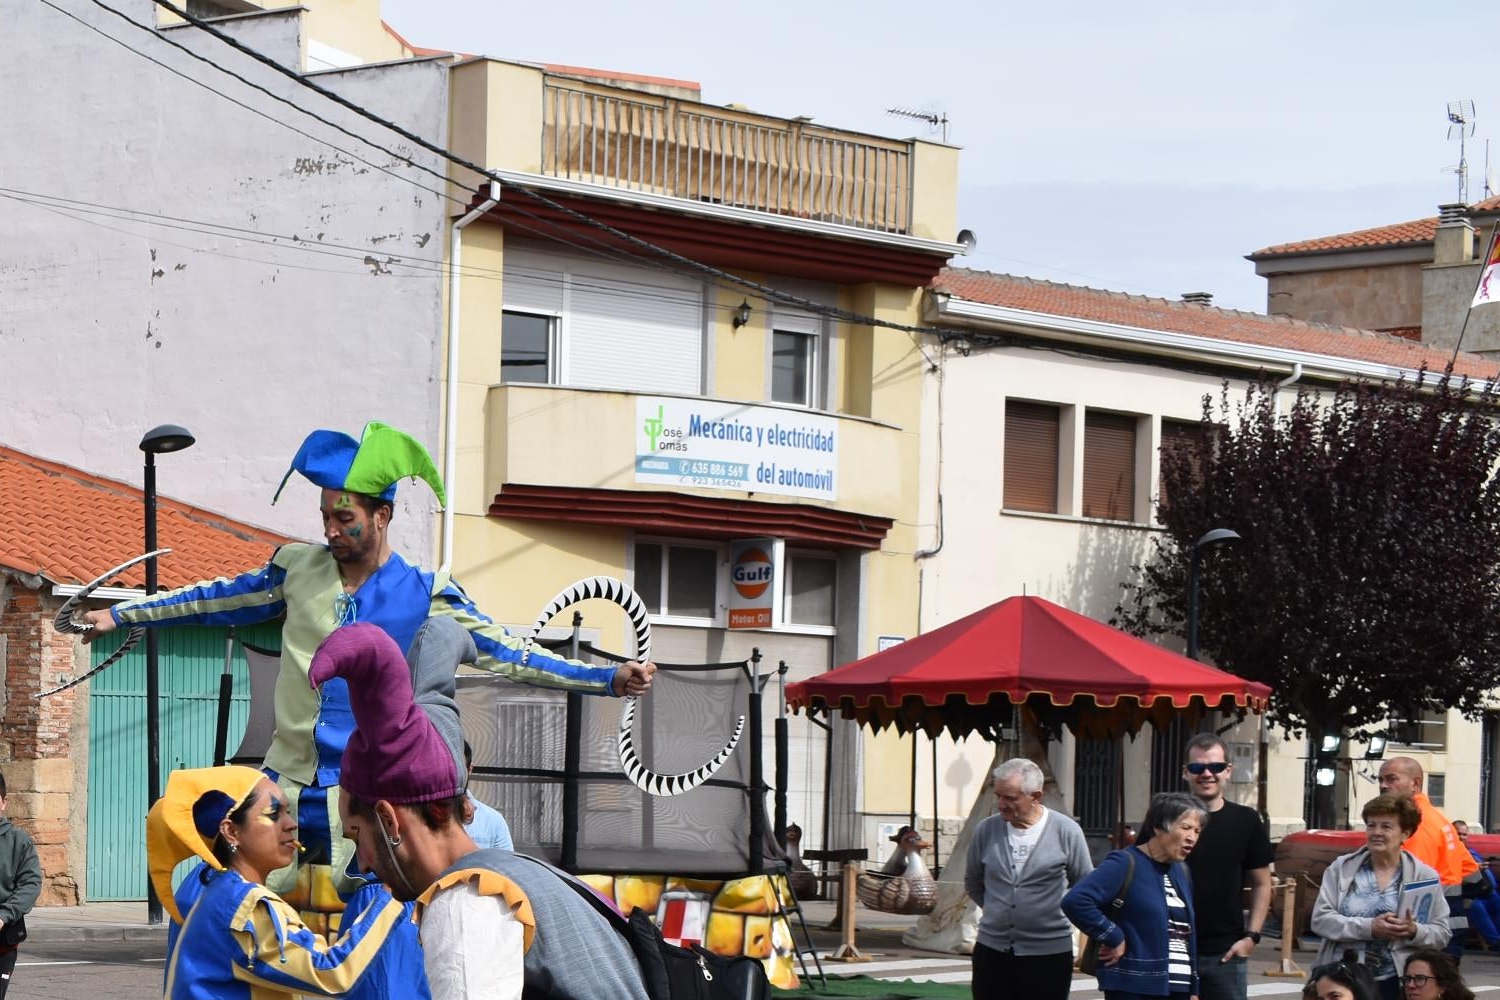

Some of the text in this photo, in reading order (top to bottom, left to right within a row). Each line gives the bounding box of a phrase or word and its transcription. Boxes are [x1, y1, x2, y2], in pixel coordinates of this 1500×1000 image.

[688, 414, 834, 453] Mecánica y electricidad
[691, 462, 709, 475] 635
[727, 464, 743, 478] 569
[756, 461, 833, 492] del automóvil
[734, 566, 771, 581] Gulf
[731, 613, 770, 624] Motor Oil
